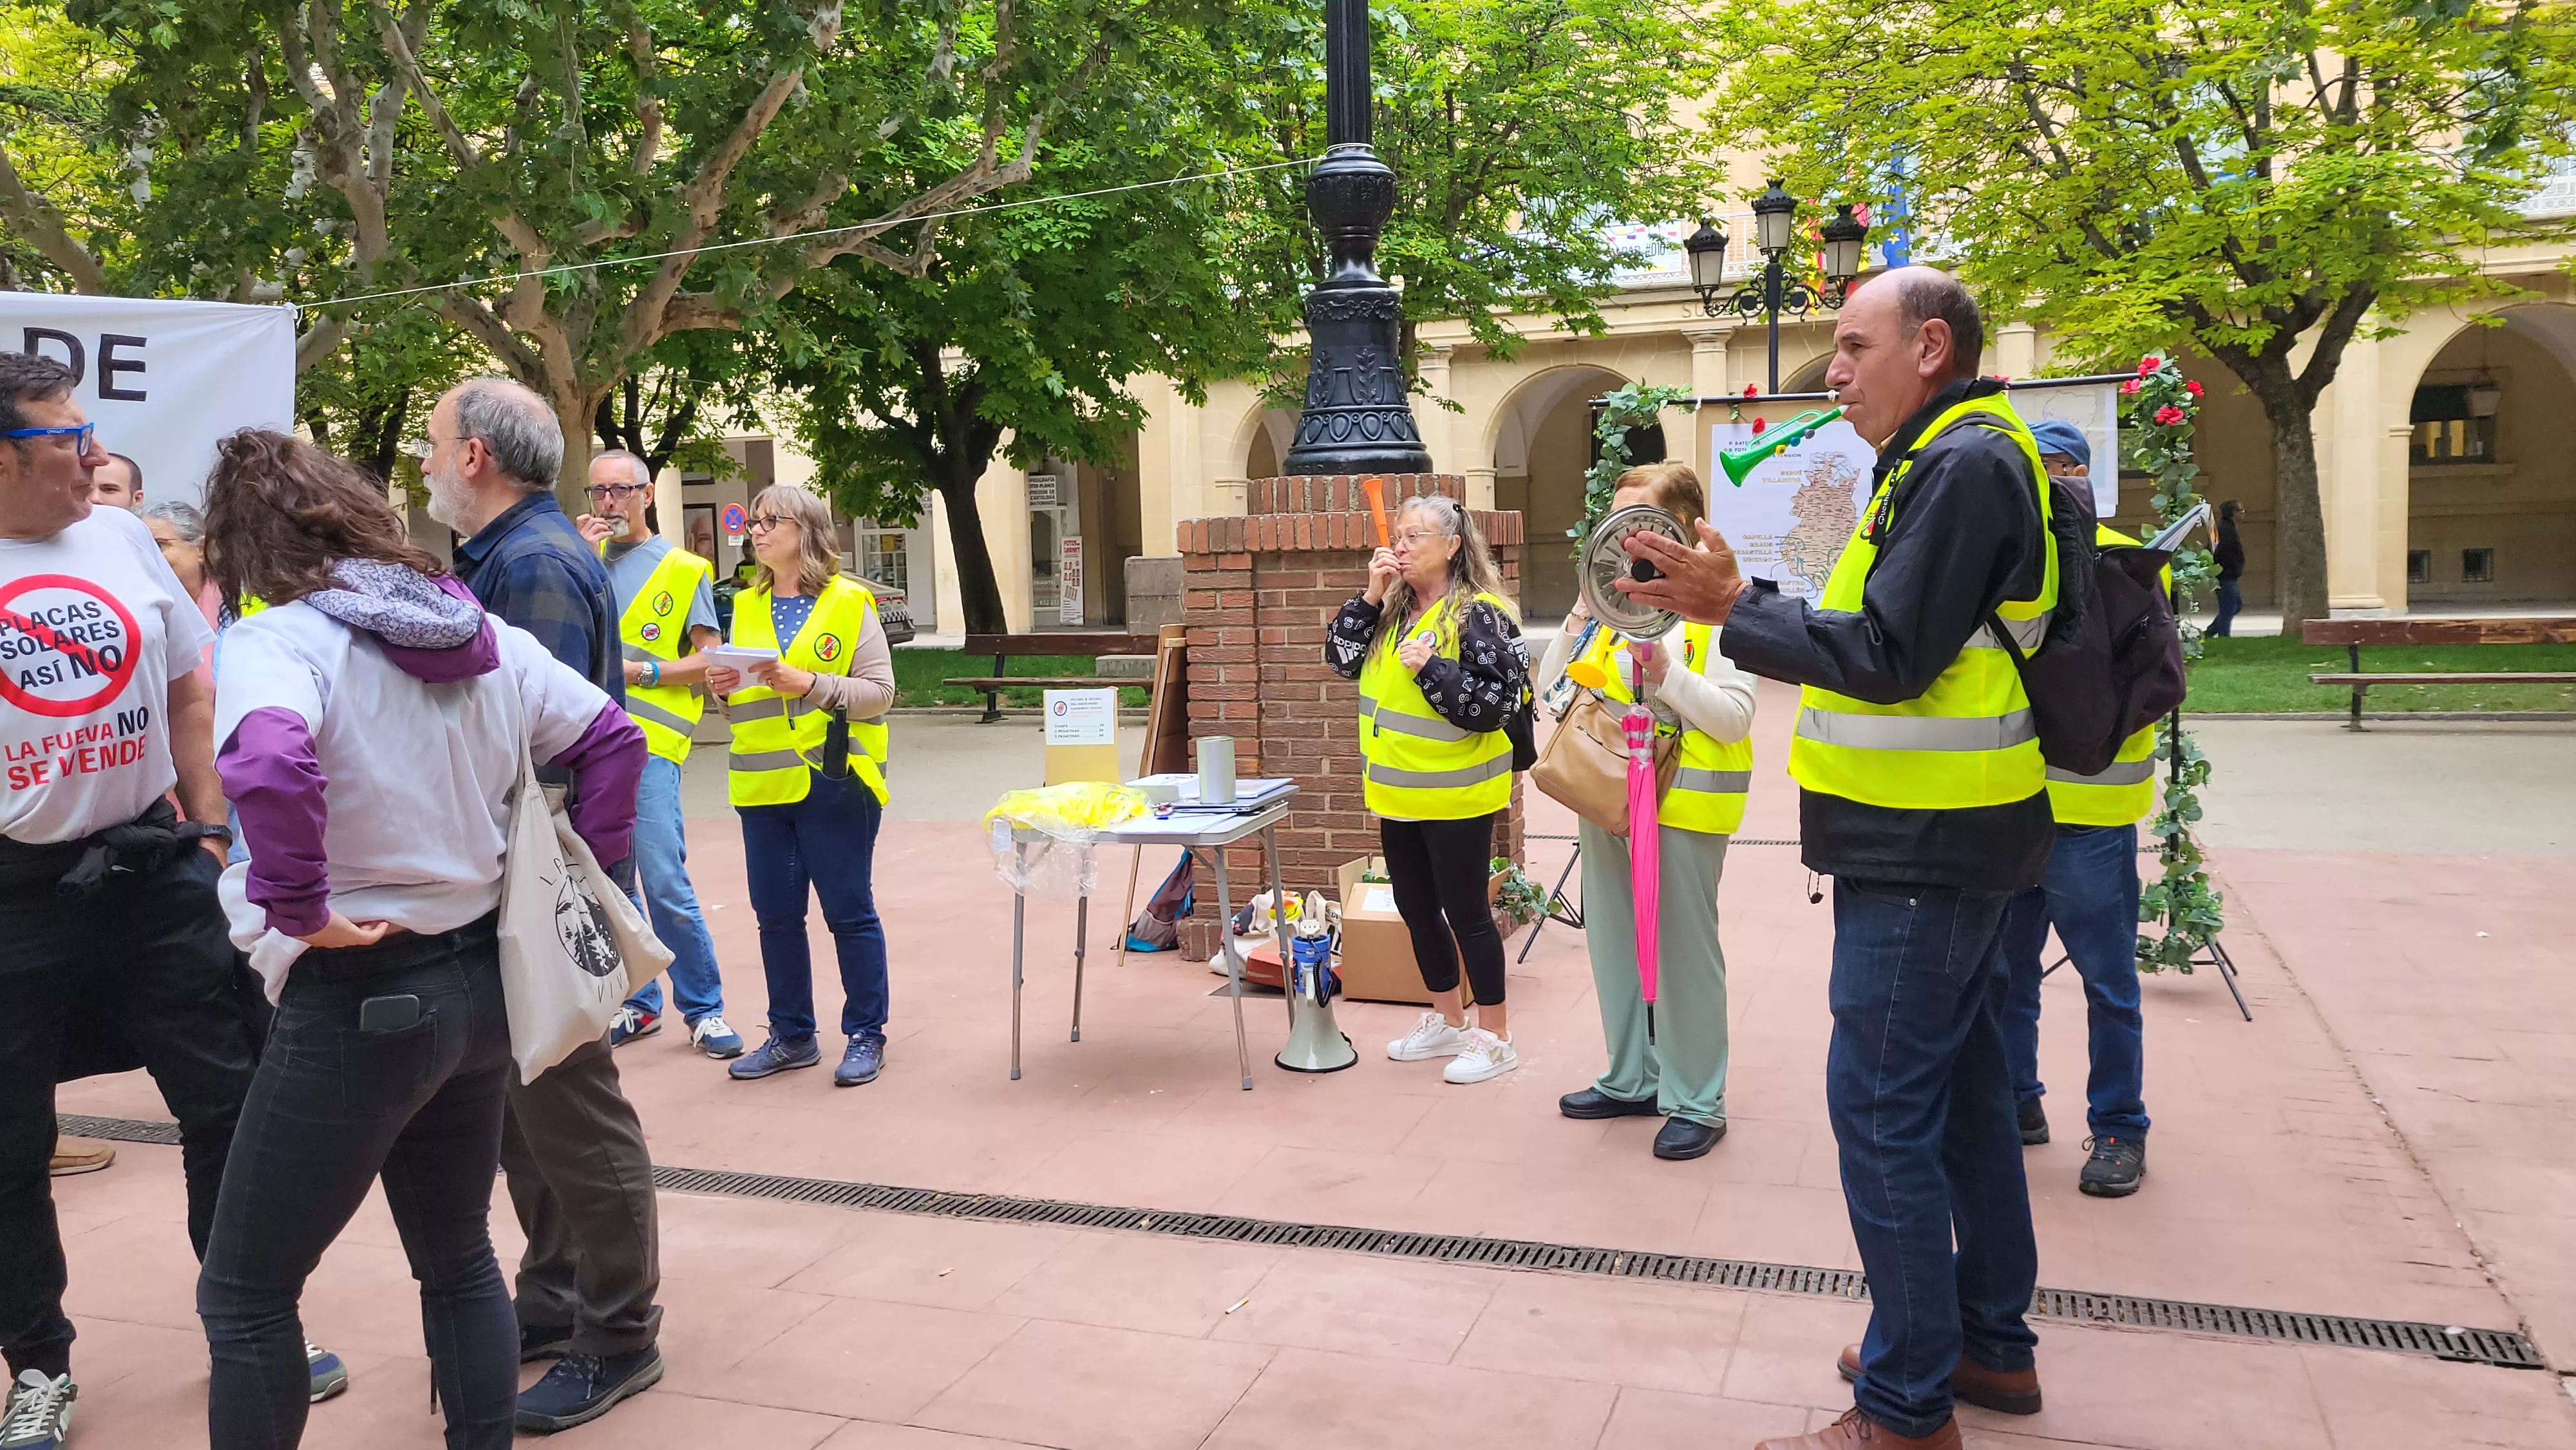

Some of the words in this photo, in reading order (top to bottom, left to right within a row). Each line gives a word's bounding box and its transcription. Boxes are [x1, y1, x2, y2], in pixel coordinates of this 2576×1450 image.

[23, 327, 147, 402] DE
[0, 601, 102, 637] PLACAS
[1, 620, 120, 660] SOLARES
[21, 659, 64, 690] ASÍ
[68, 645, 122, 679] NO
[4, 741, 37, 762] LA
[41, 722, 114, 755] FUEVA
[117, 706, 149, 737] NO
[7, 760, 50, 791] SE
[57, 733, 147, 777] VENDE
